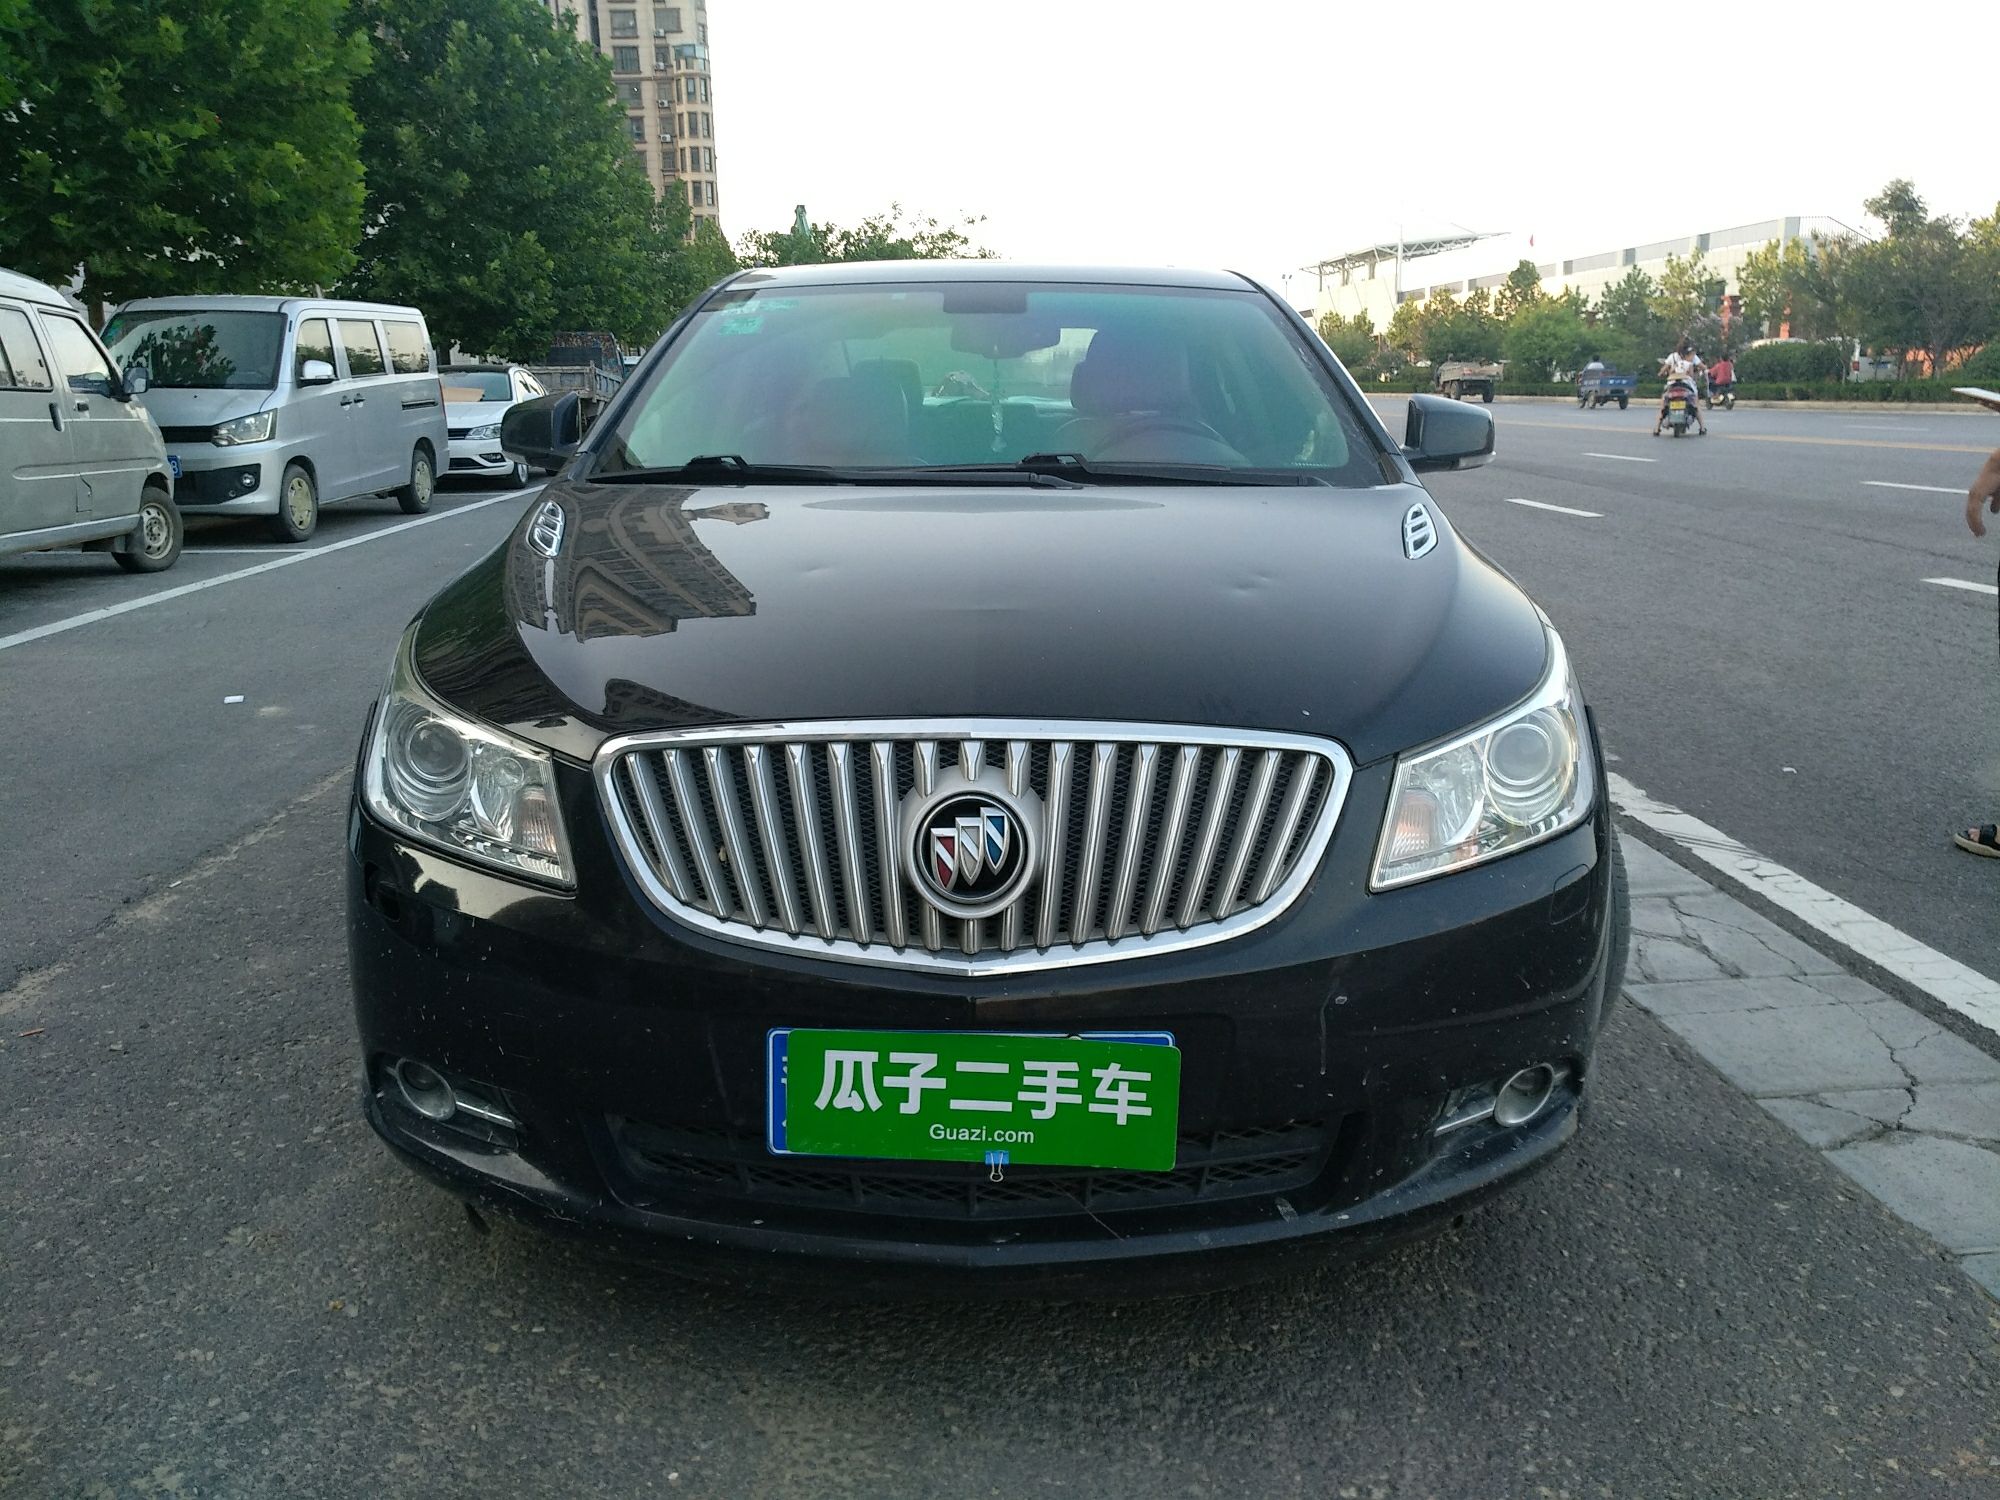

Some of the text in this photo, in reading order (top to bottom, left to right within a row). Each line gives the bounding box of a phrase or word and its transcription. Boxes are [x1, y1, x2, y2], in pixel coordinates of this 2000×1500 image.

[814, 1050, 1152, 1125] 瓜子二手车
[929, 1123, 1034, 1143] Guazi.com
